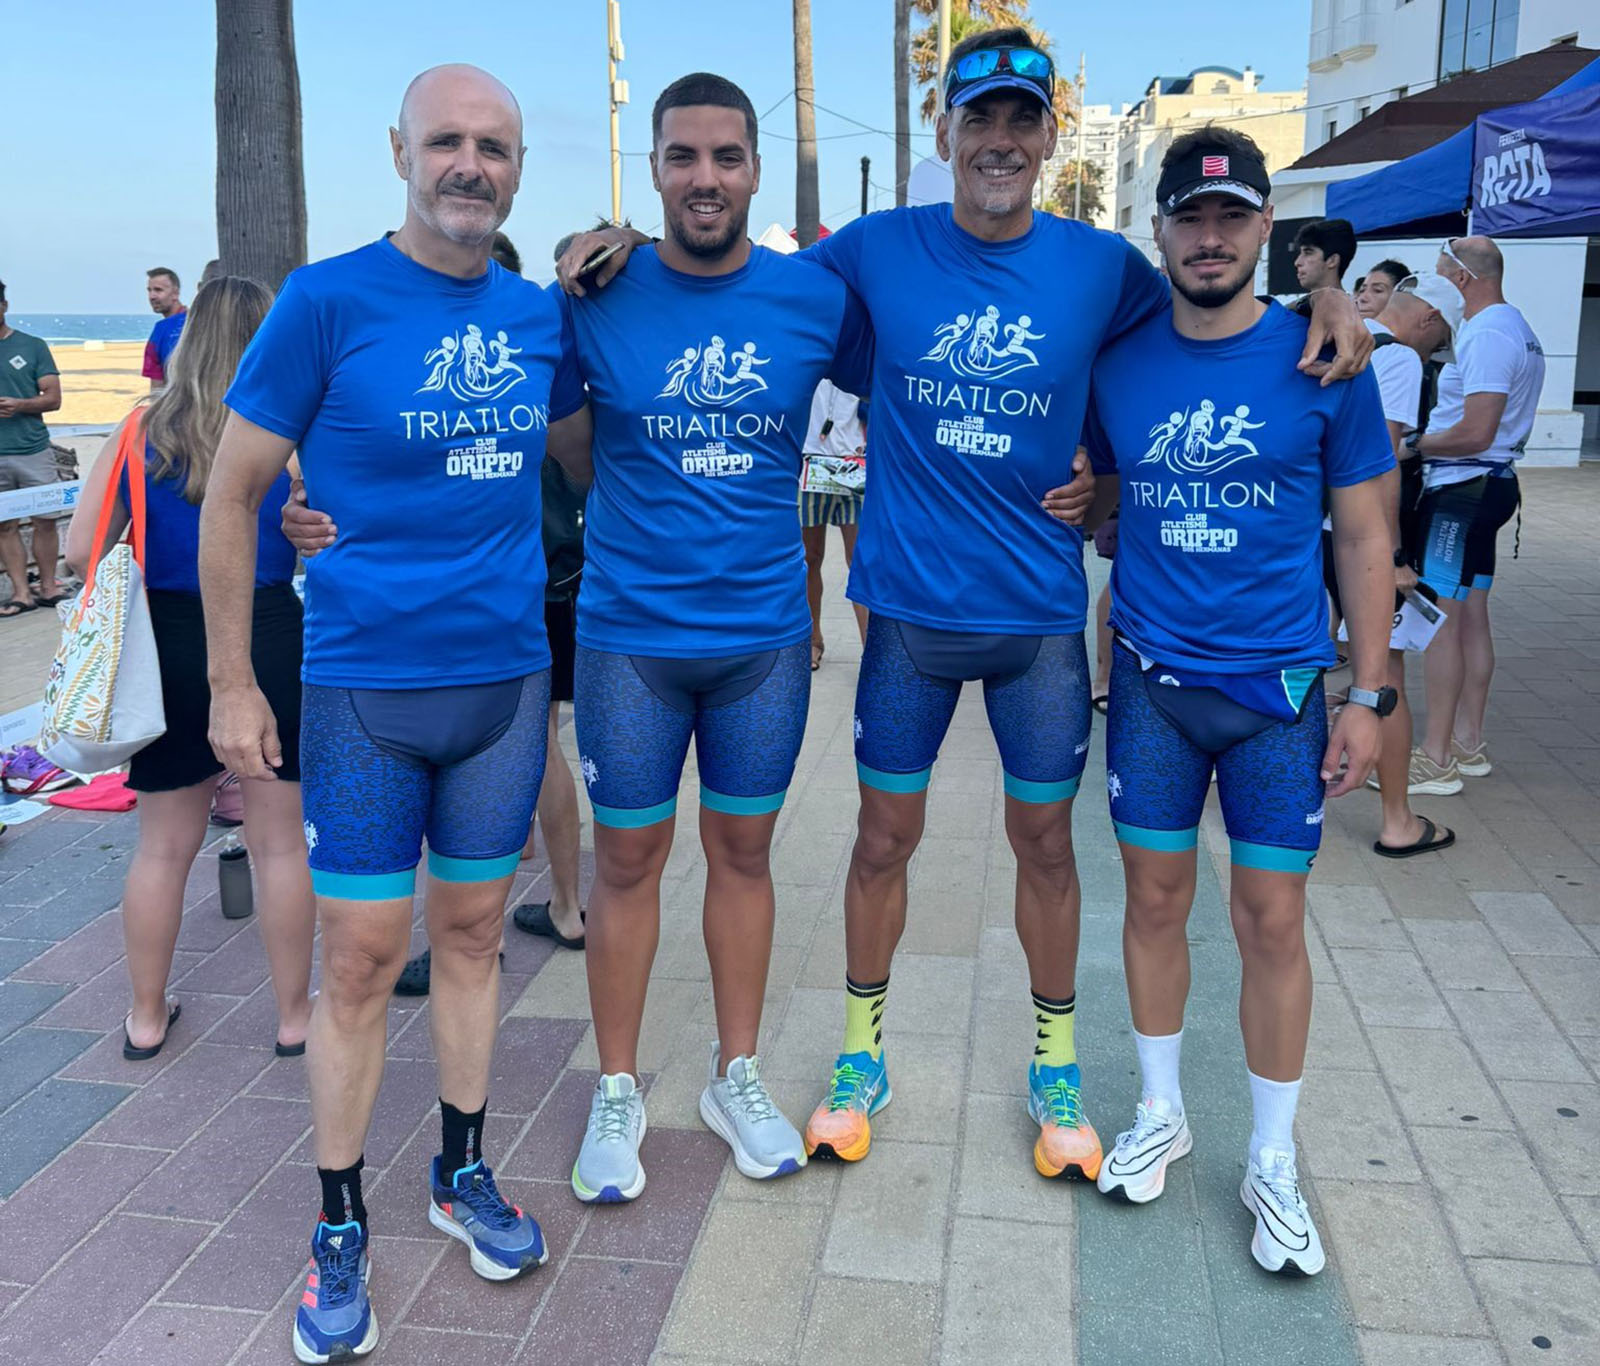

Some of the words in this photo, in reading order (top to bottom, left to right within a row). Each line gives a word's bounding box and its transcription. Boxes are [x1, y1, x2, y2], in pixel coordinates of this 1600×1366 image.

[1480, 142, 1552, 208] ROTA
[904, 375, 1052, 417] TRIATLON
[400, 404, 549, 439] TRIATLON
[641, 413, 785, 440] TRIATLON
[938, 418, 985, 432] ATLETISMO
[963, 415, 985, 424] CLUB
[475, 437, 497, 446] CLUB
[935, 426, 1012, 454] ORIPPO
[448, 446, 497, 456] ATLETISMO
[682, 449, 726, 457] ATLETISMO
[446, 451, 523, 476] ORIPPO
[681, 453, 754, 474] ORIPPO
[1129, 481, 1275, 508] TRIATLON
[1161, 520, 1208, 528] ATLETISMO
[1185, 513, 1207, 521] CLUB
[1160, 528, 1238, 547] ORIPPO
